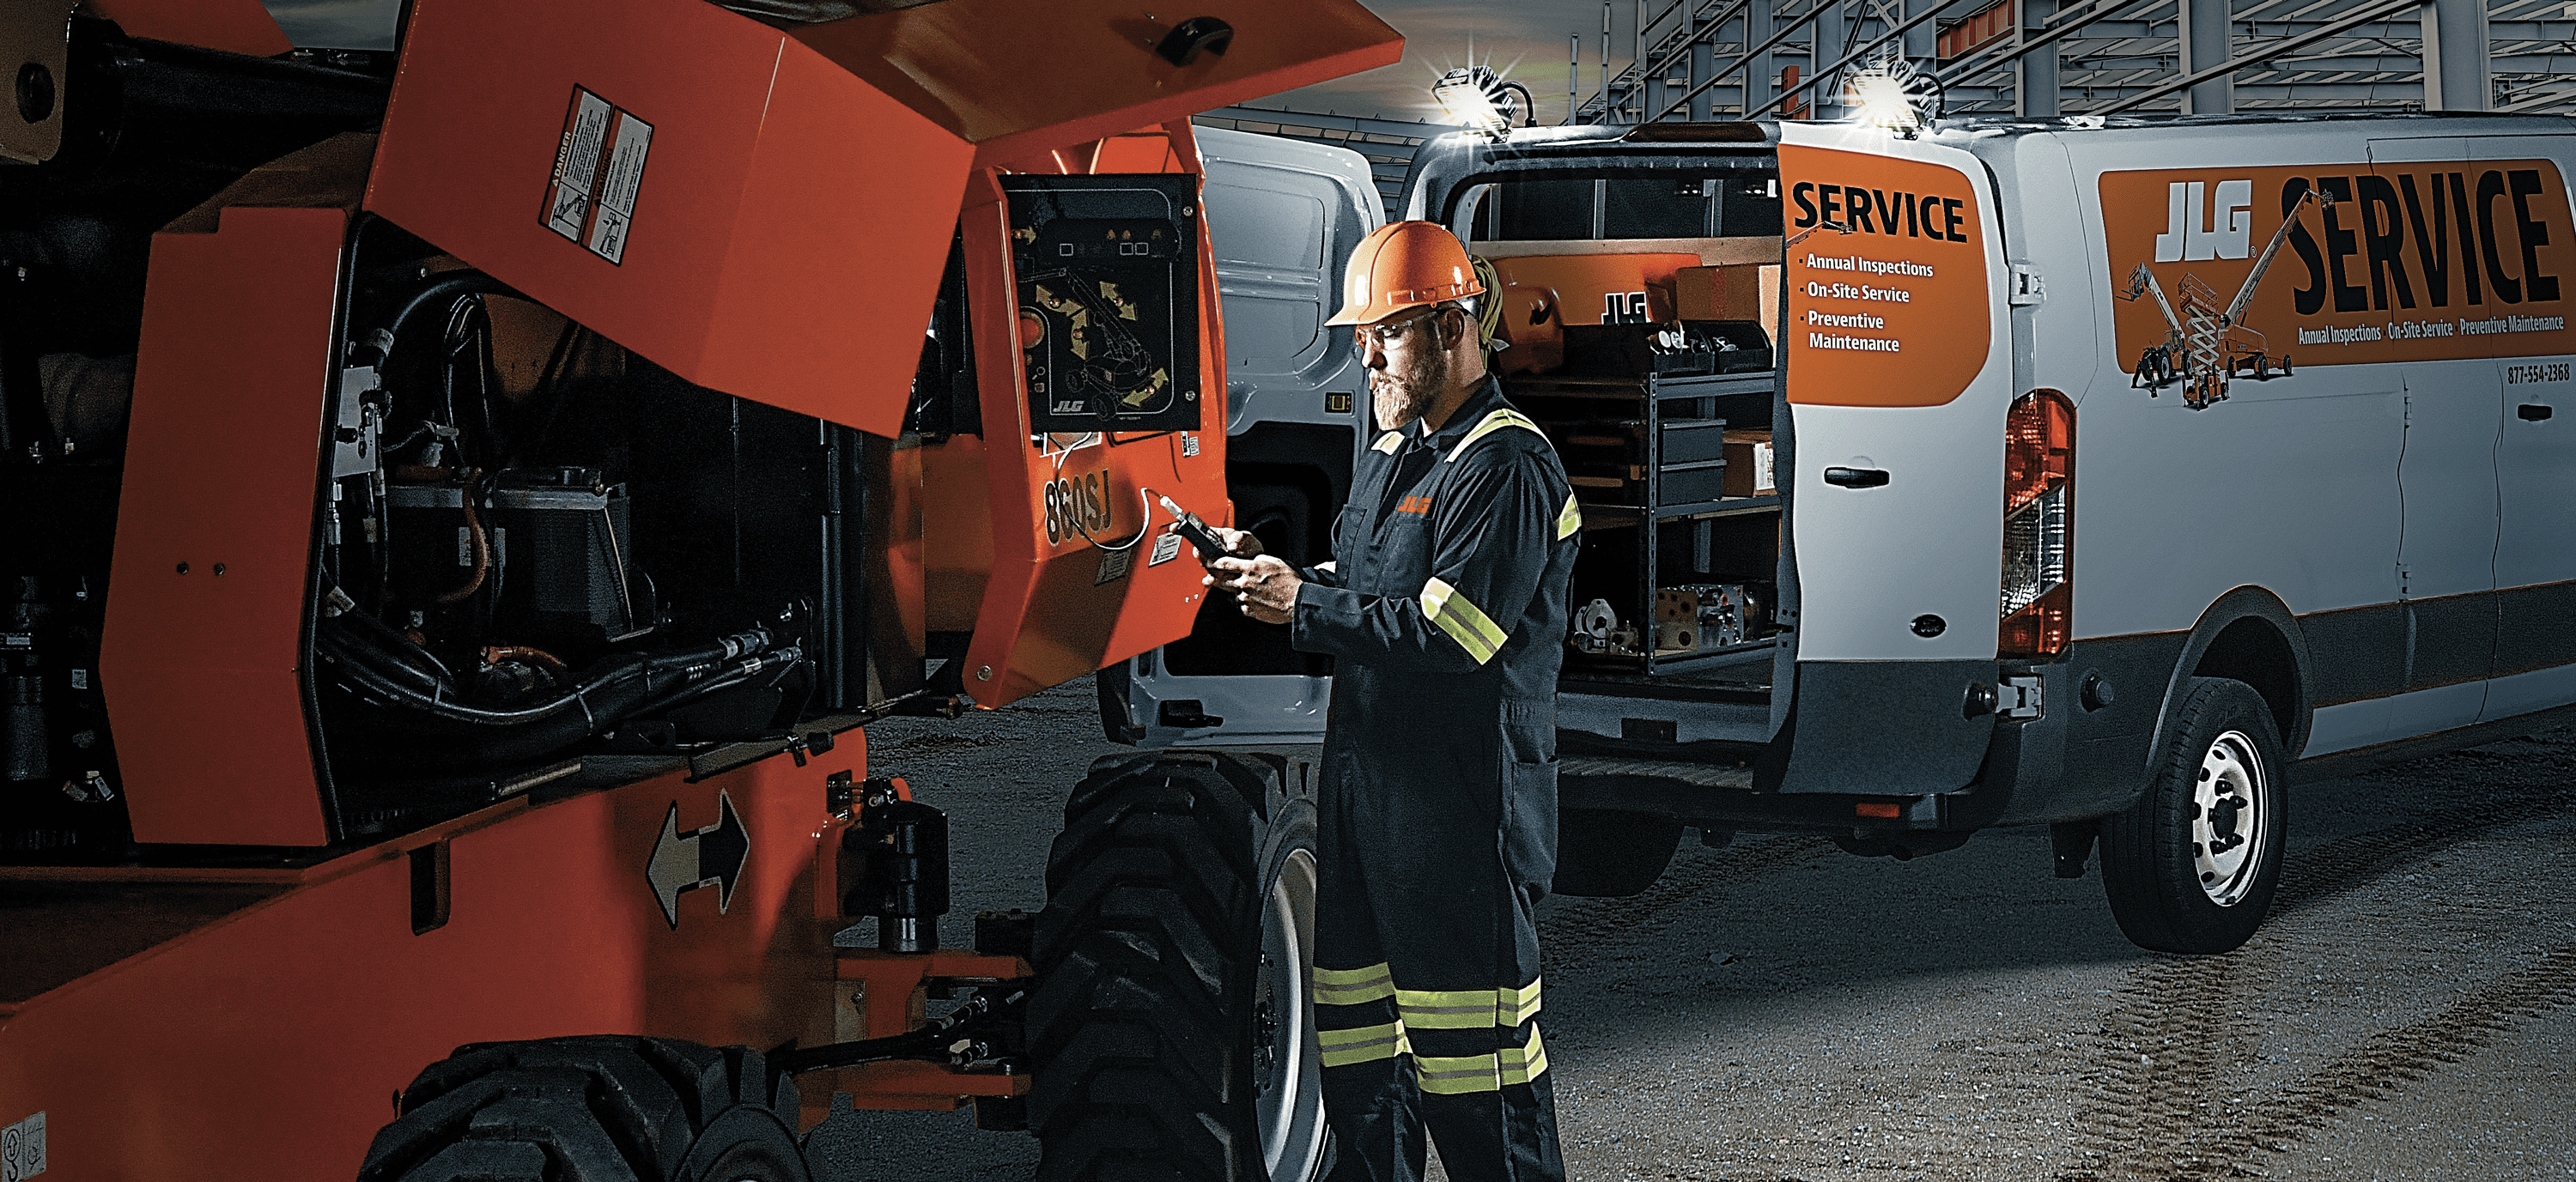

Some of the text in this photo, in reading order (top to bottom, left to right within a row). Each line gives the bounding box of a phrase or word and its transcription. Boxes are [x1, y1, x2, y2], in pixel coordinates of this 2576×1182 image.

[554, 131, 571, 178] DANGER
[596, 148, 614, 197] WARNING
[1792, 181, 1968, 244] SERVICE
[2155, 179, 2251, 262] JLG
[2281, 169, 2561, 316] SERVICE
[1807, 253, 1934, 277] Annual Inspections
[1601, 292, 1649, 324] JLG
[1807, 282, 1910, 303] On-Site Service
[1808, 310, 1884, 330] Preventive
[2299, 314, 2564, 345] Annual Inspections On-Site Service Preventive Maintenance
[1809, 332, 1899, 352] Maintenance
[2507, 363, 2570, 385] 877-554-2368
[1053, 401, 1084, 412] JLG
[1044, 469, 1111, 547] 860SJ
[1397, 495, 1432, 514] JLG
